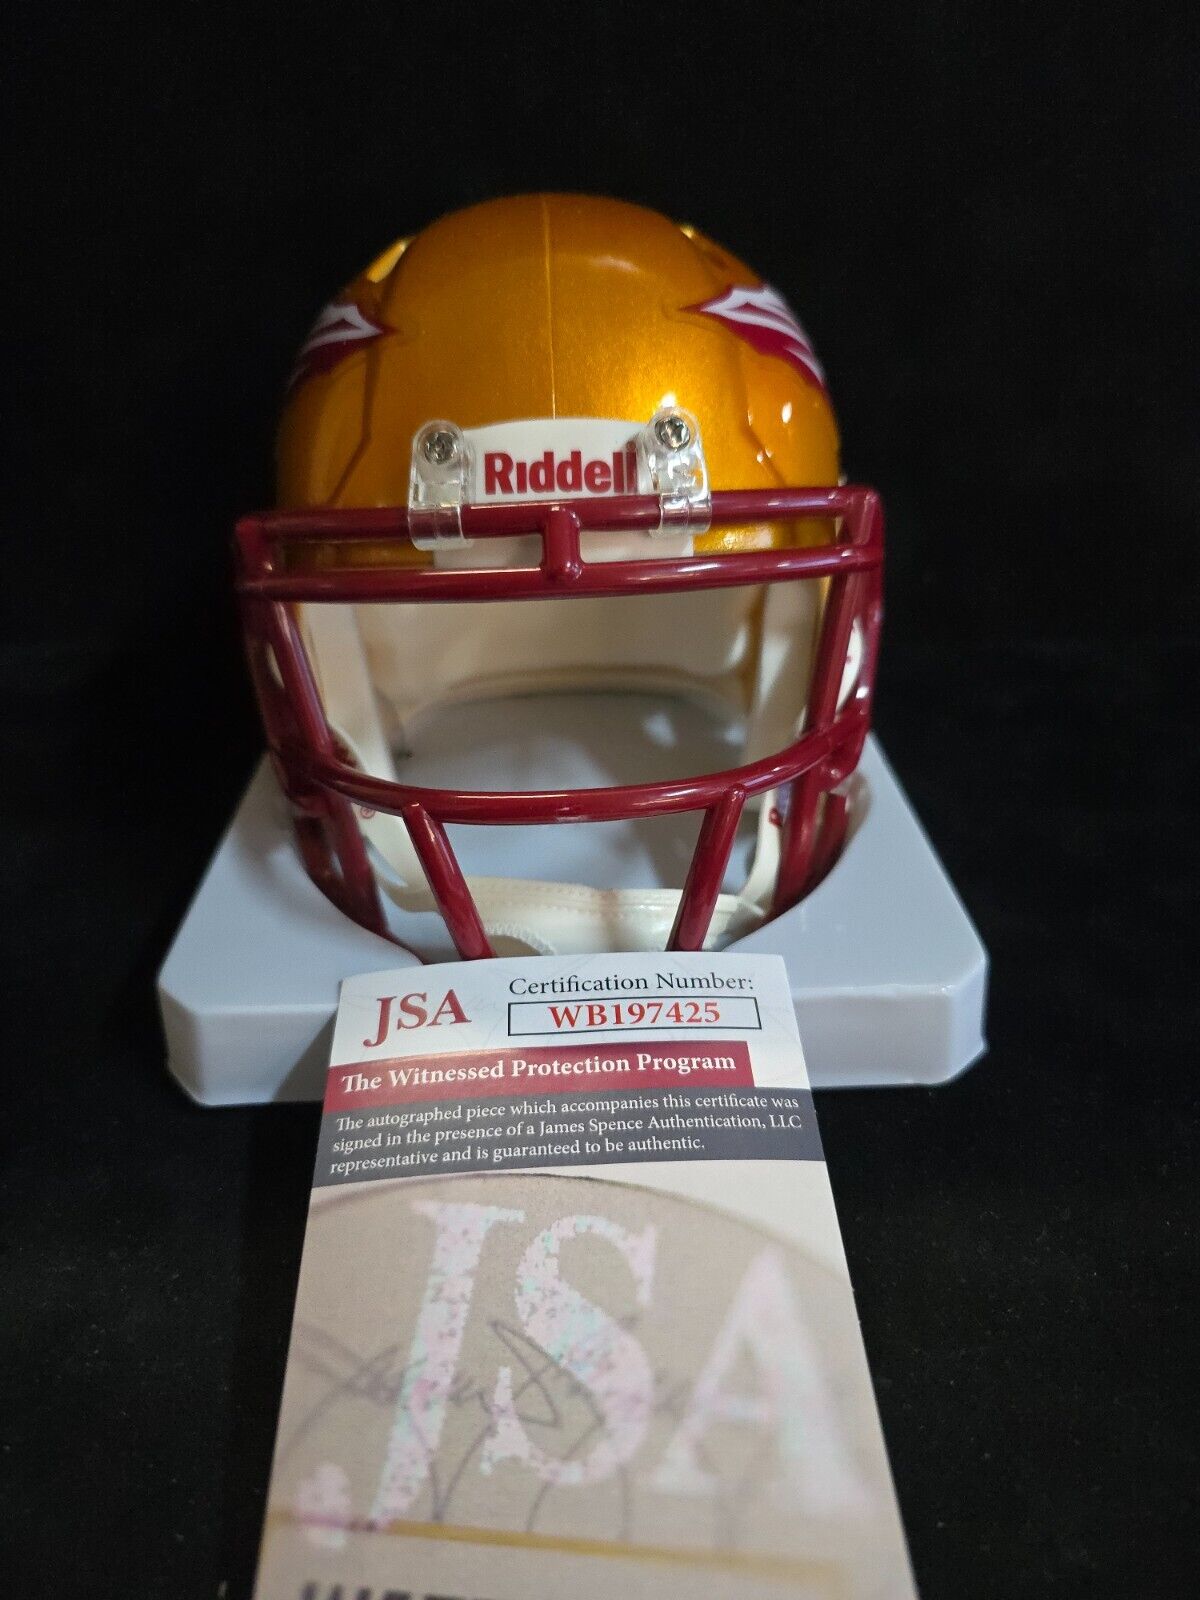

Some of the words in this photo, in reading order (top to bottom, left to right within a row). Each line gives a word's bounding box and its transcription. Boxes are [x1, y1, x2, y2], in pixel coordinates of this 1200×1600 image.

[483, 449, 638, 495] Riddell
[508, 974, 649, 996] Certification
[656, 972, 754, 991] Number:
[362, 988, 472, 1047] JSA
[550, 1002, 720, 1029] WB197425
[341, 1073, 382, 1093] The
[388, 1060, 504, 1086] Witnessed
[511, 1055, 631, 1078] Protection
[636, 1053, 736, 1075] Program
[336, 1117, 364, 1132] The
[367, 1105, 462, 1129] autographed
[466, 1105, 506, 1121] piece
[510, 1099, 556, 1115] which
[561, 1096, 659, 1114] accompanies
[662, 1093, 691, 1108] this
[695, 1093, 768, 1108] certificate
[771, 1097, 799, 1108] was
[333, 1132, 382, 1155] signed
[386, 1133, 402, 1147] in
[406, 1129, 430, 1144] the
[435, 1125, 502, 1146] presence
[506, 1121, 524, 1136] of
[526, 1124, 535, 1135] a
[539, 1120, 584, 1137] James
[589, 1117, 643, 1135] Spence
[647, 1114, 766, 1130] Authentication,
[769, 1114, 802, 1129] LLC
[330, 1150, 438, 1176] representative
[442, 1146, 471, 1162] and
[476, 1144, 489, 1160] is
[493, 1139, 580, 1162] guaranteed
[585, 1140, 601, 1153] to
[605, 1137, 624, 1151] be
[628, 1136, 705, 1151] authentic.
[295, 1200, 884, 1548] JSA
